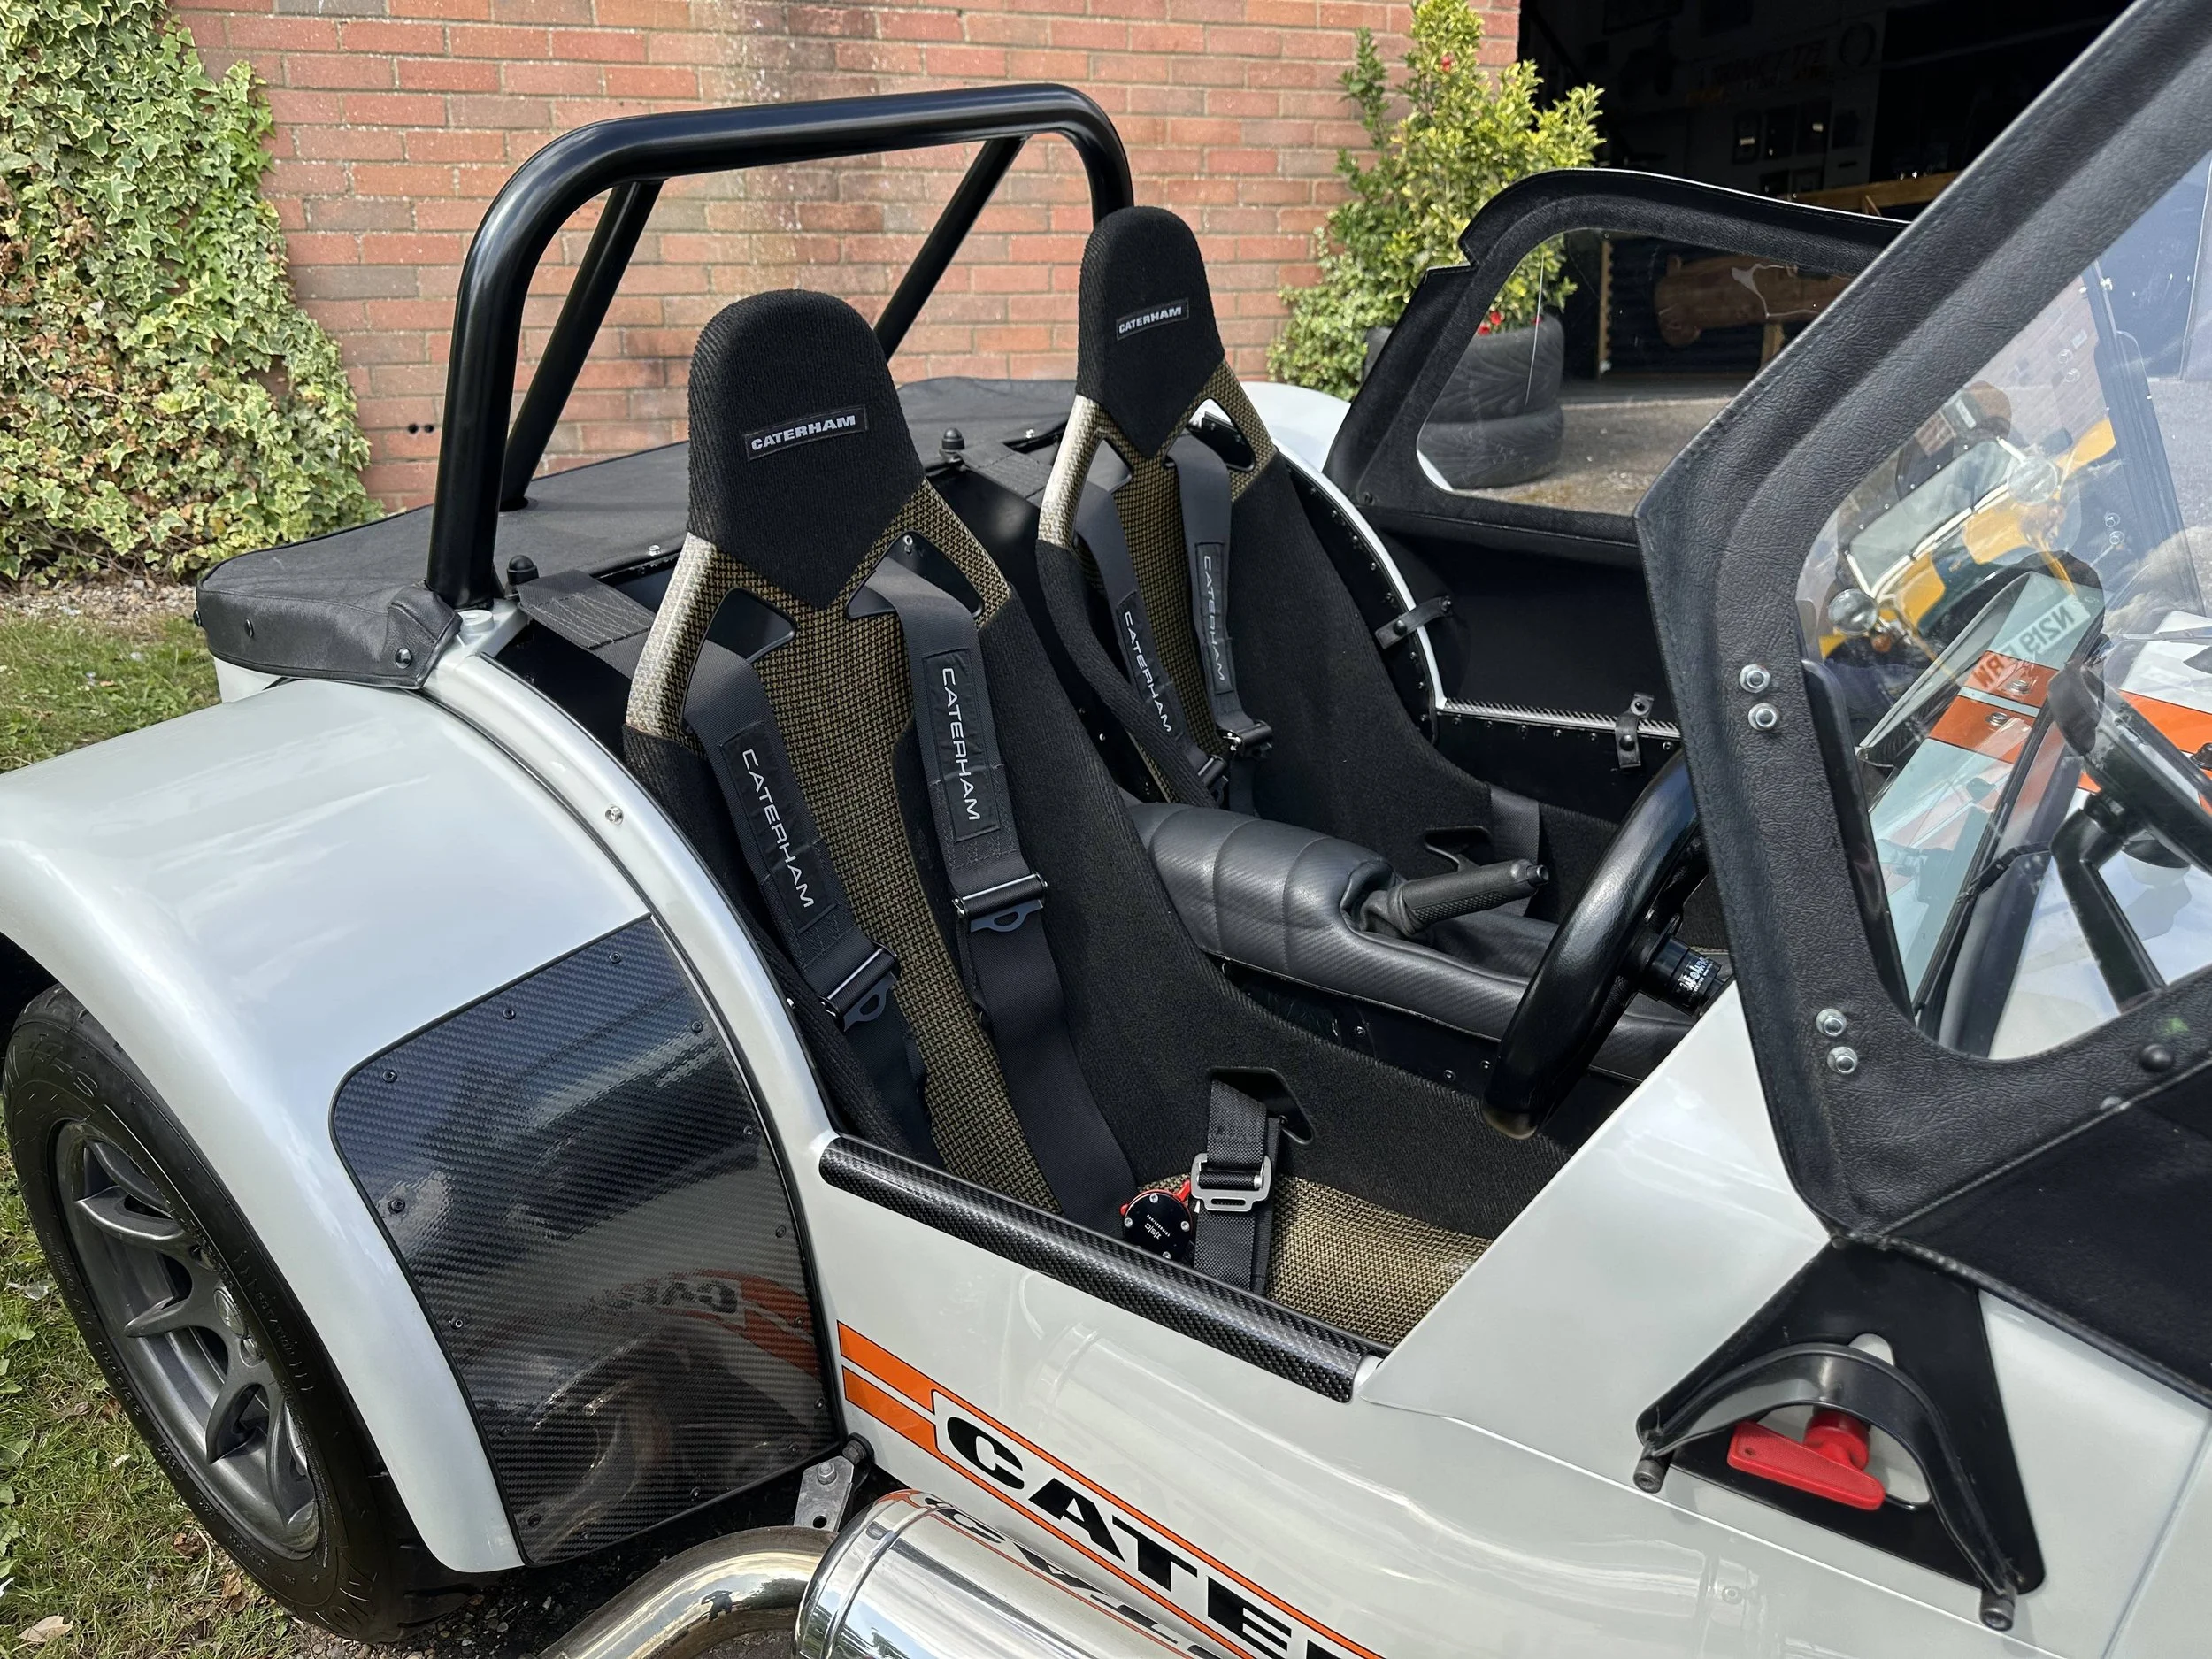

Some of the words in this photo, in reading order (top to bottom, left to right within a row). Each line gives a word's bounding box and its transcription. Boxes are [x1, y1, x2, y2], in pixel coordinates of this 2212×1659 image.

[1118, 306, 1182, 334] CATERHAM
[751, 415, 856, 450] CATERHAM
[1125, 611, 1171, 732] CATERHAM
[1204, 556, 1225, 680] CATERHAM
[942, 668, 980, 820] CATERHAM
[742, 749, 815, 908] CATERHAM
[947, 1416, 1342, 1659] CATE
